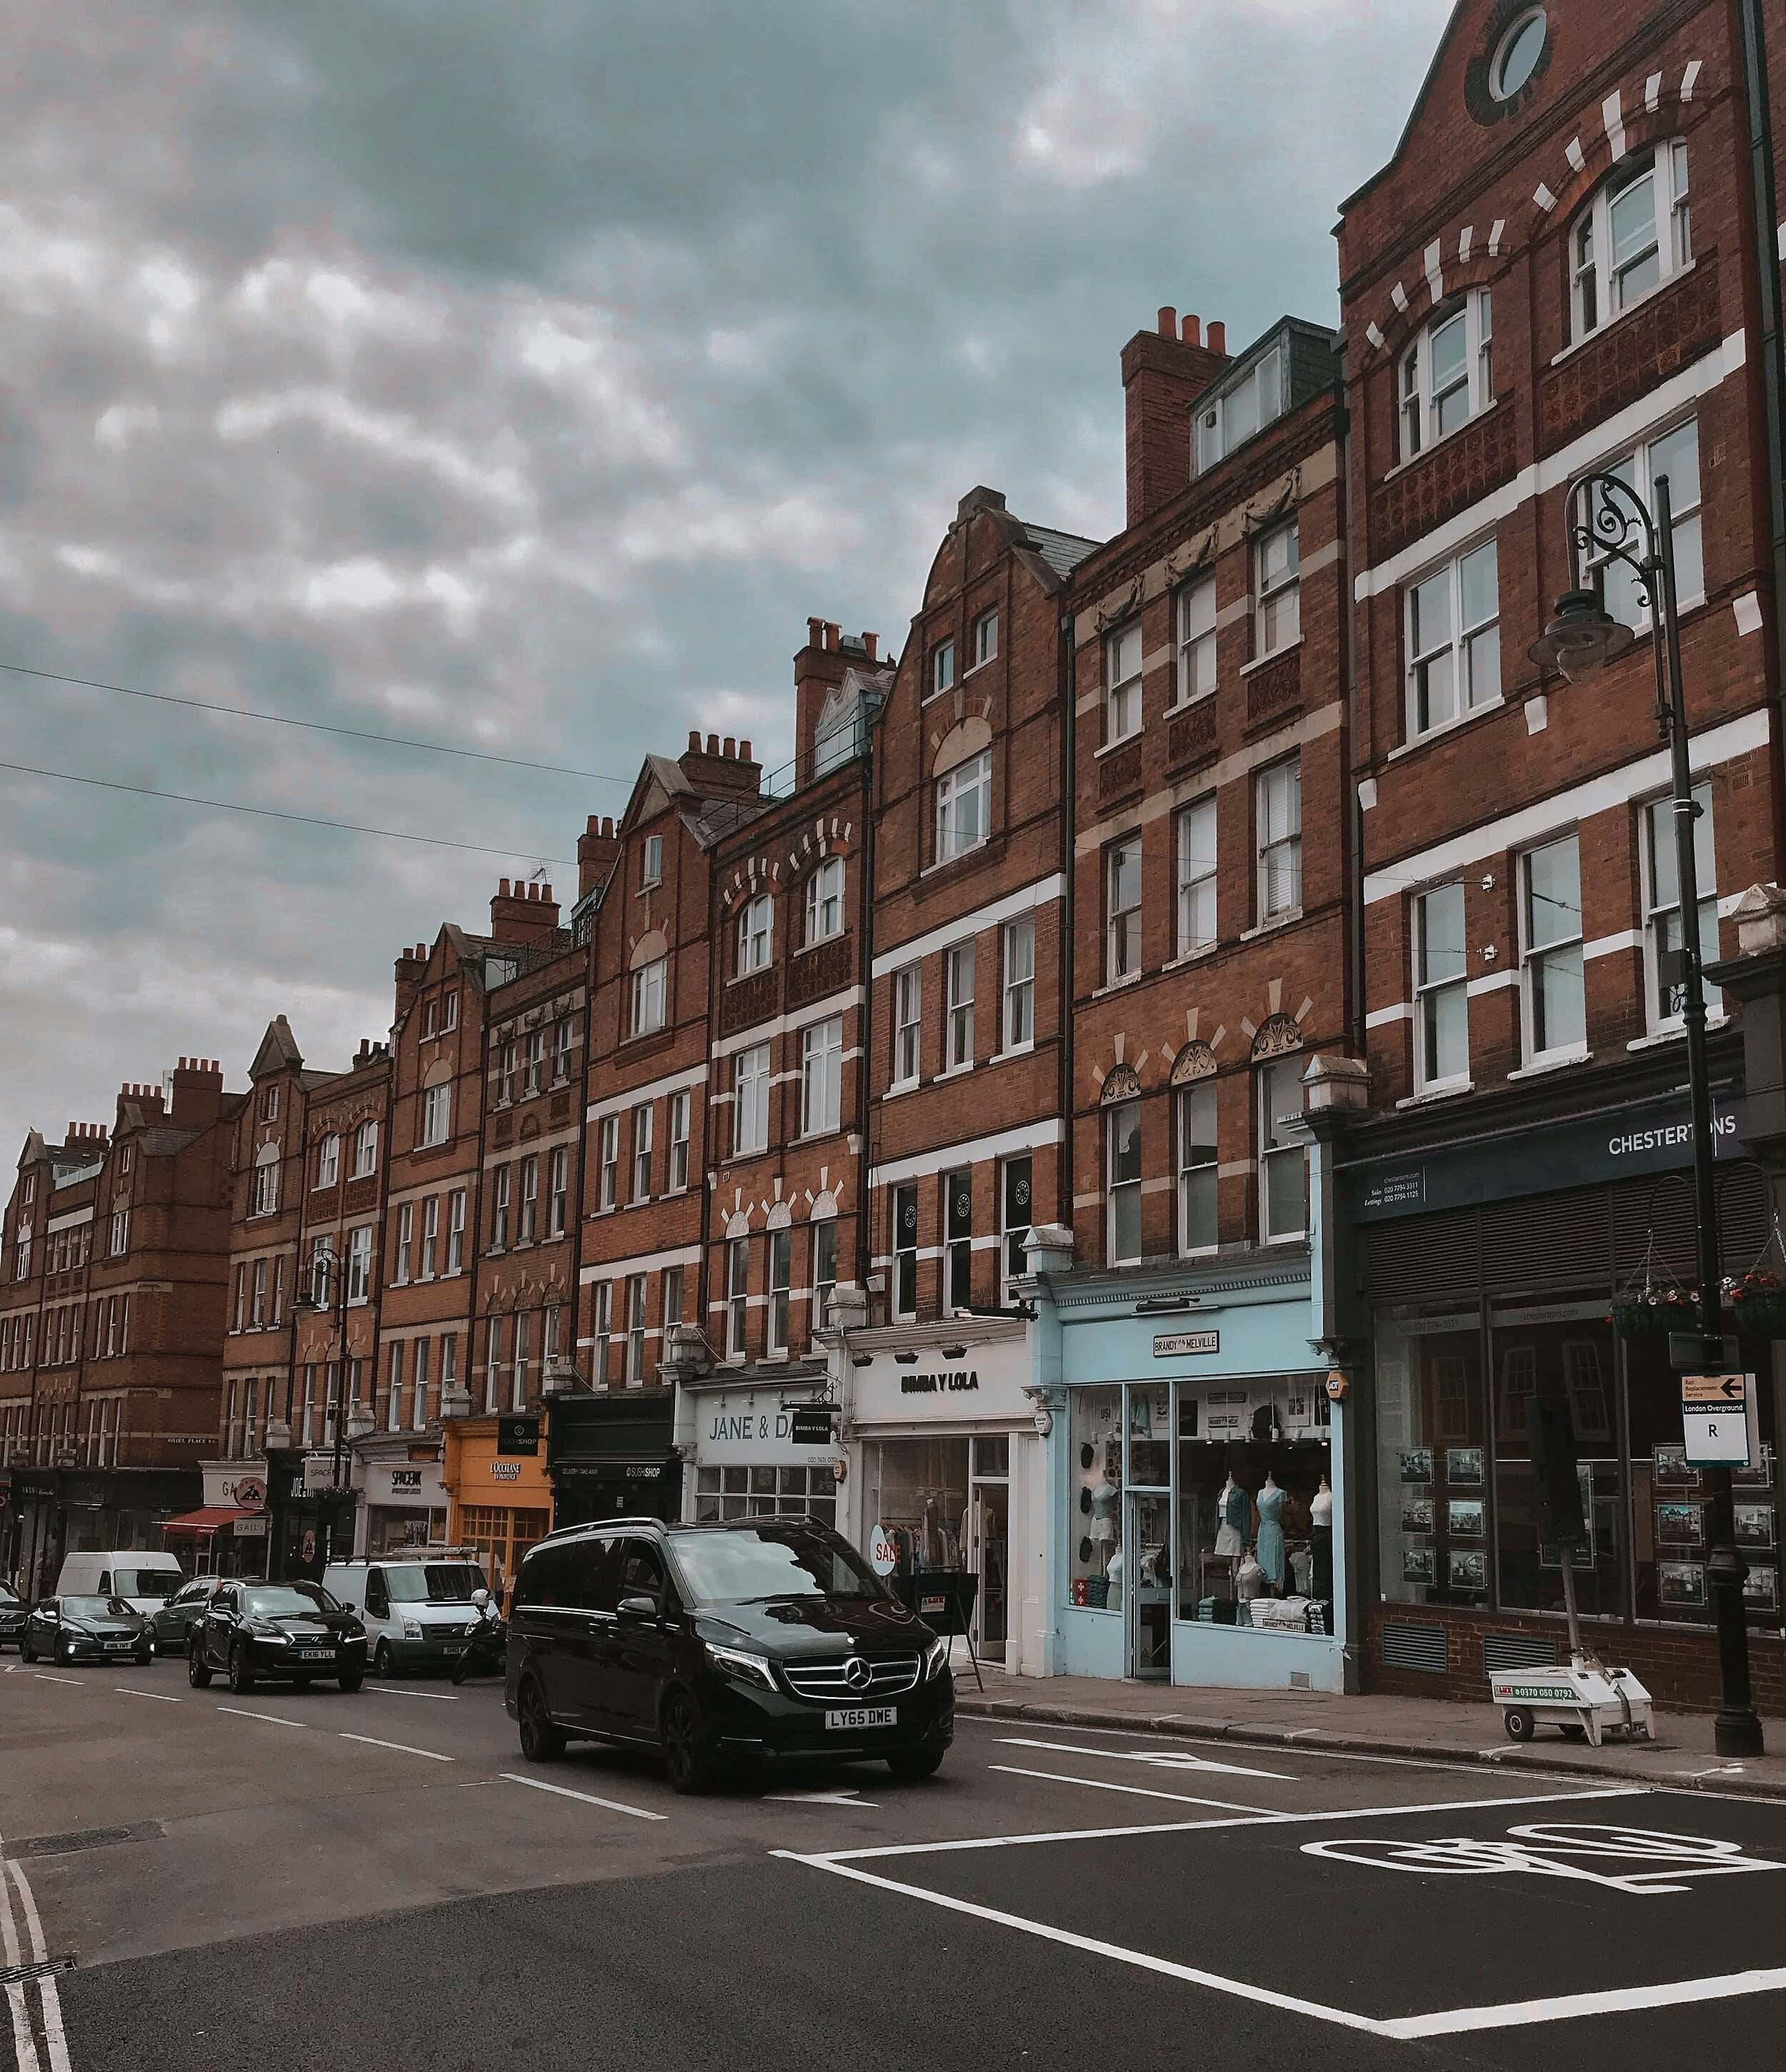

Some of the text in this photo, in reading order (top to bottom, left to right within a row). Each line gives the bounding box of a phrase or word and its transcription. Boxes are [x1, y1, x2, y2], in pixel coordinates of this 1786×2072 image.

[1609, 1115, 1736, 1155] CHESTERTNS
[1395, 1192, 1406, 1201] 7794
[1154, 1336, 1216, 1351] BRANDY MELVILLE
[901, 1371, 978, 1393] BIMBA Y LOLA
[1707, 1404, 1742, 1413] Overground
[709, 1416, 753, 1440] JANE
[759, 1415, 769, 1439] &
[1708, 1424, 1718, 1437] R
[291, 1478, 303, 1498] JOE
[876, 1543, 902, 1565] SALE
[1520, 1688, 1537, 1697] 0370
[1554, 1689, 1572, 1698] 0792
[831, 1709, 892, 1726] LY65 DWE
